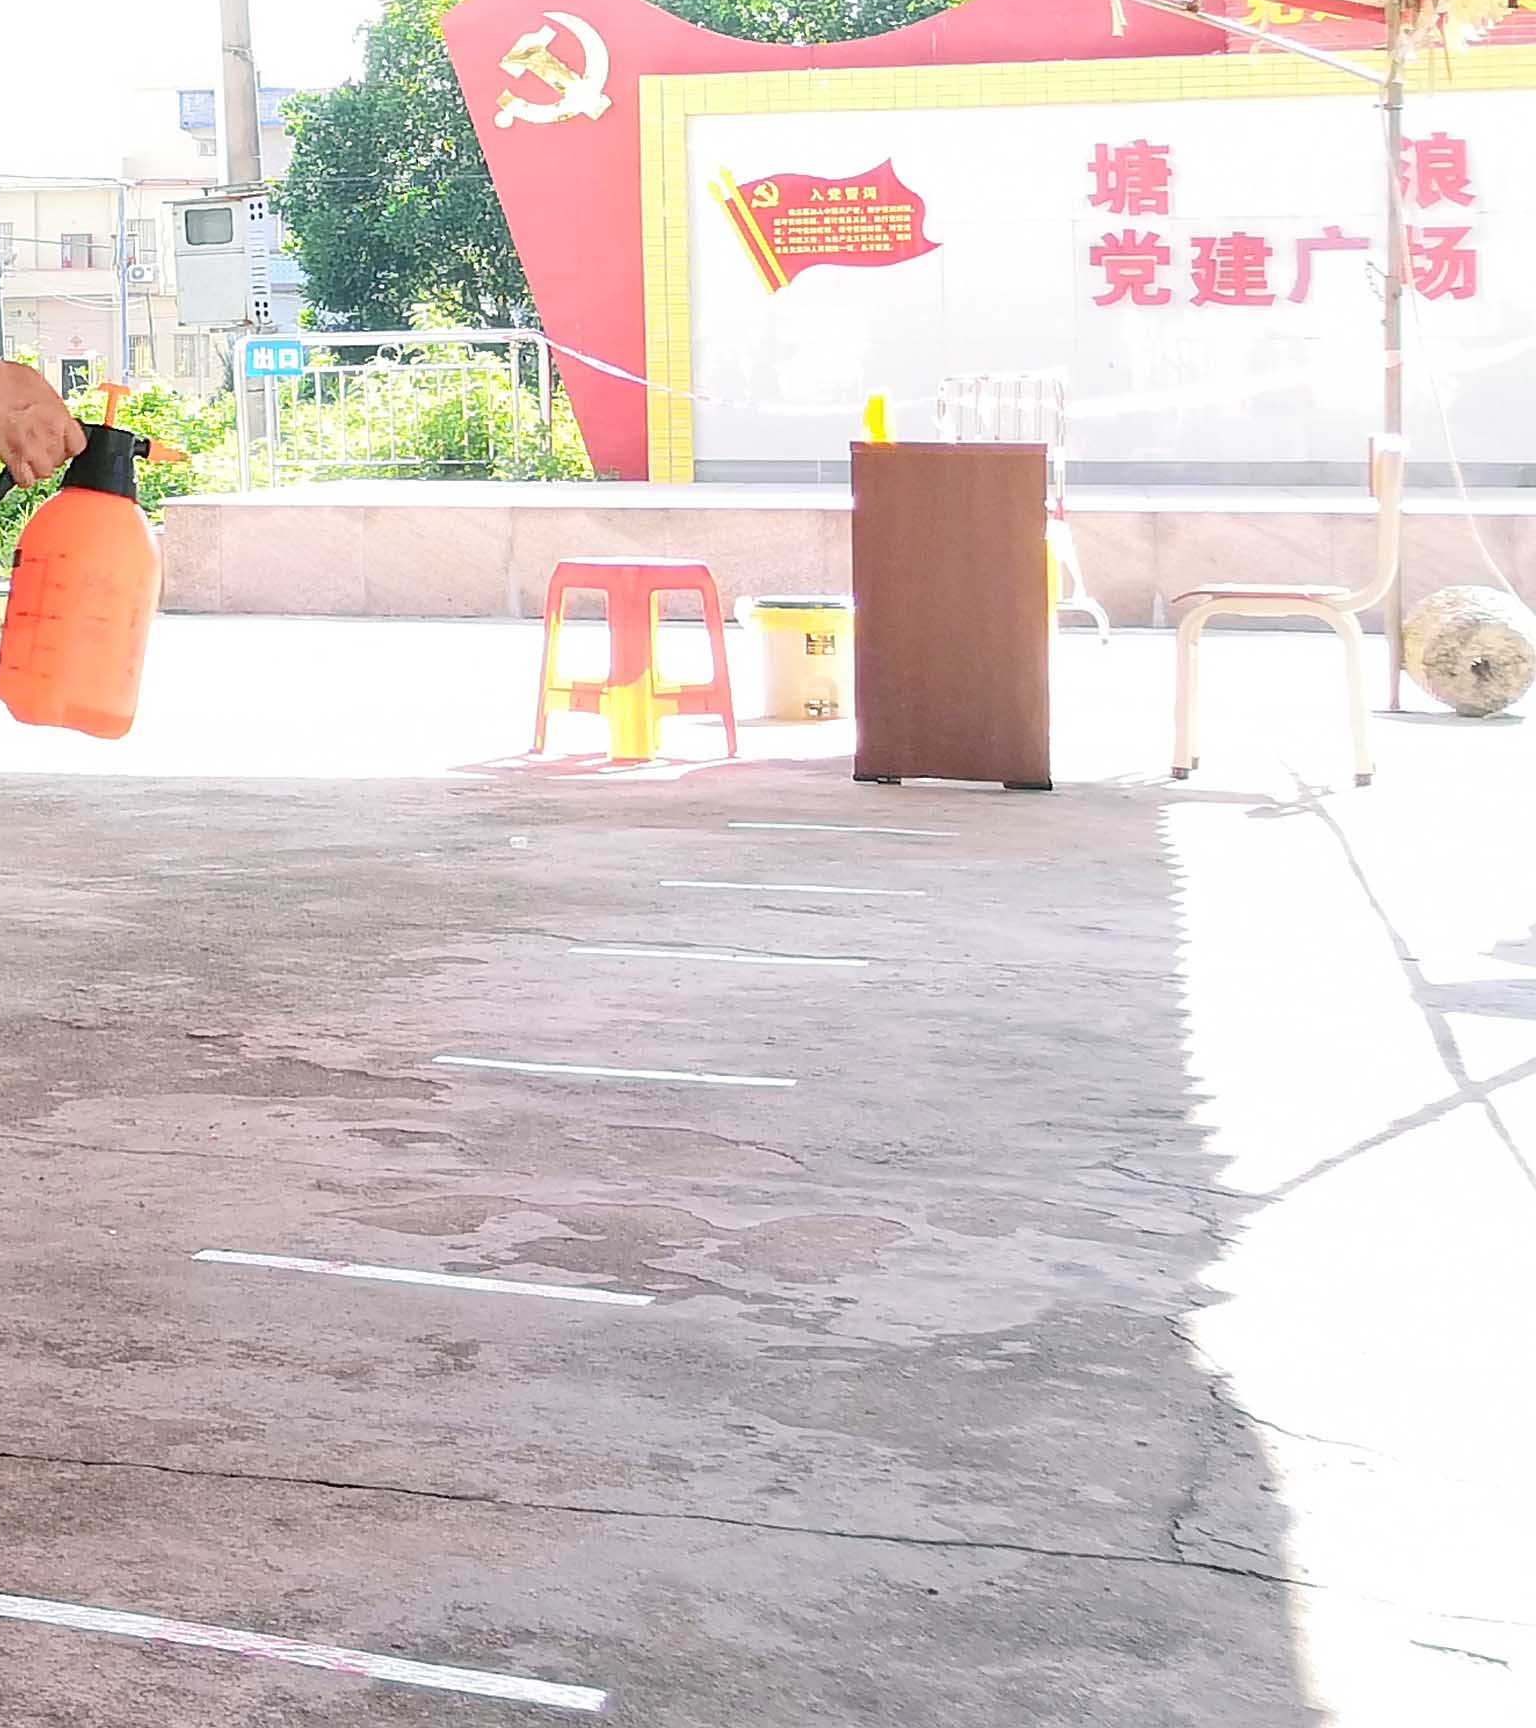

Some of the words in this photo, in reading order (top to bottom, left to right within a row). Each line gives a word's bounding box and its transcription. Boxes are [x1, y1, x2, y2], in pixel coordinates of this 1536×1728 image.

[1088, 138, 1173, 216] 塘
[1089, 225, 1478, 307] 党建广场
[252, 346, 299, 370] 出口
